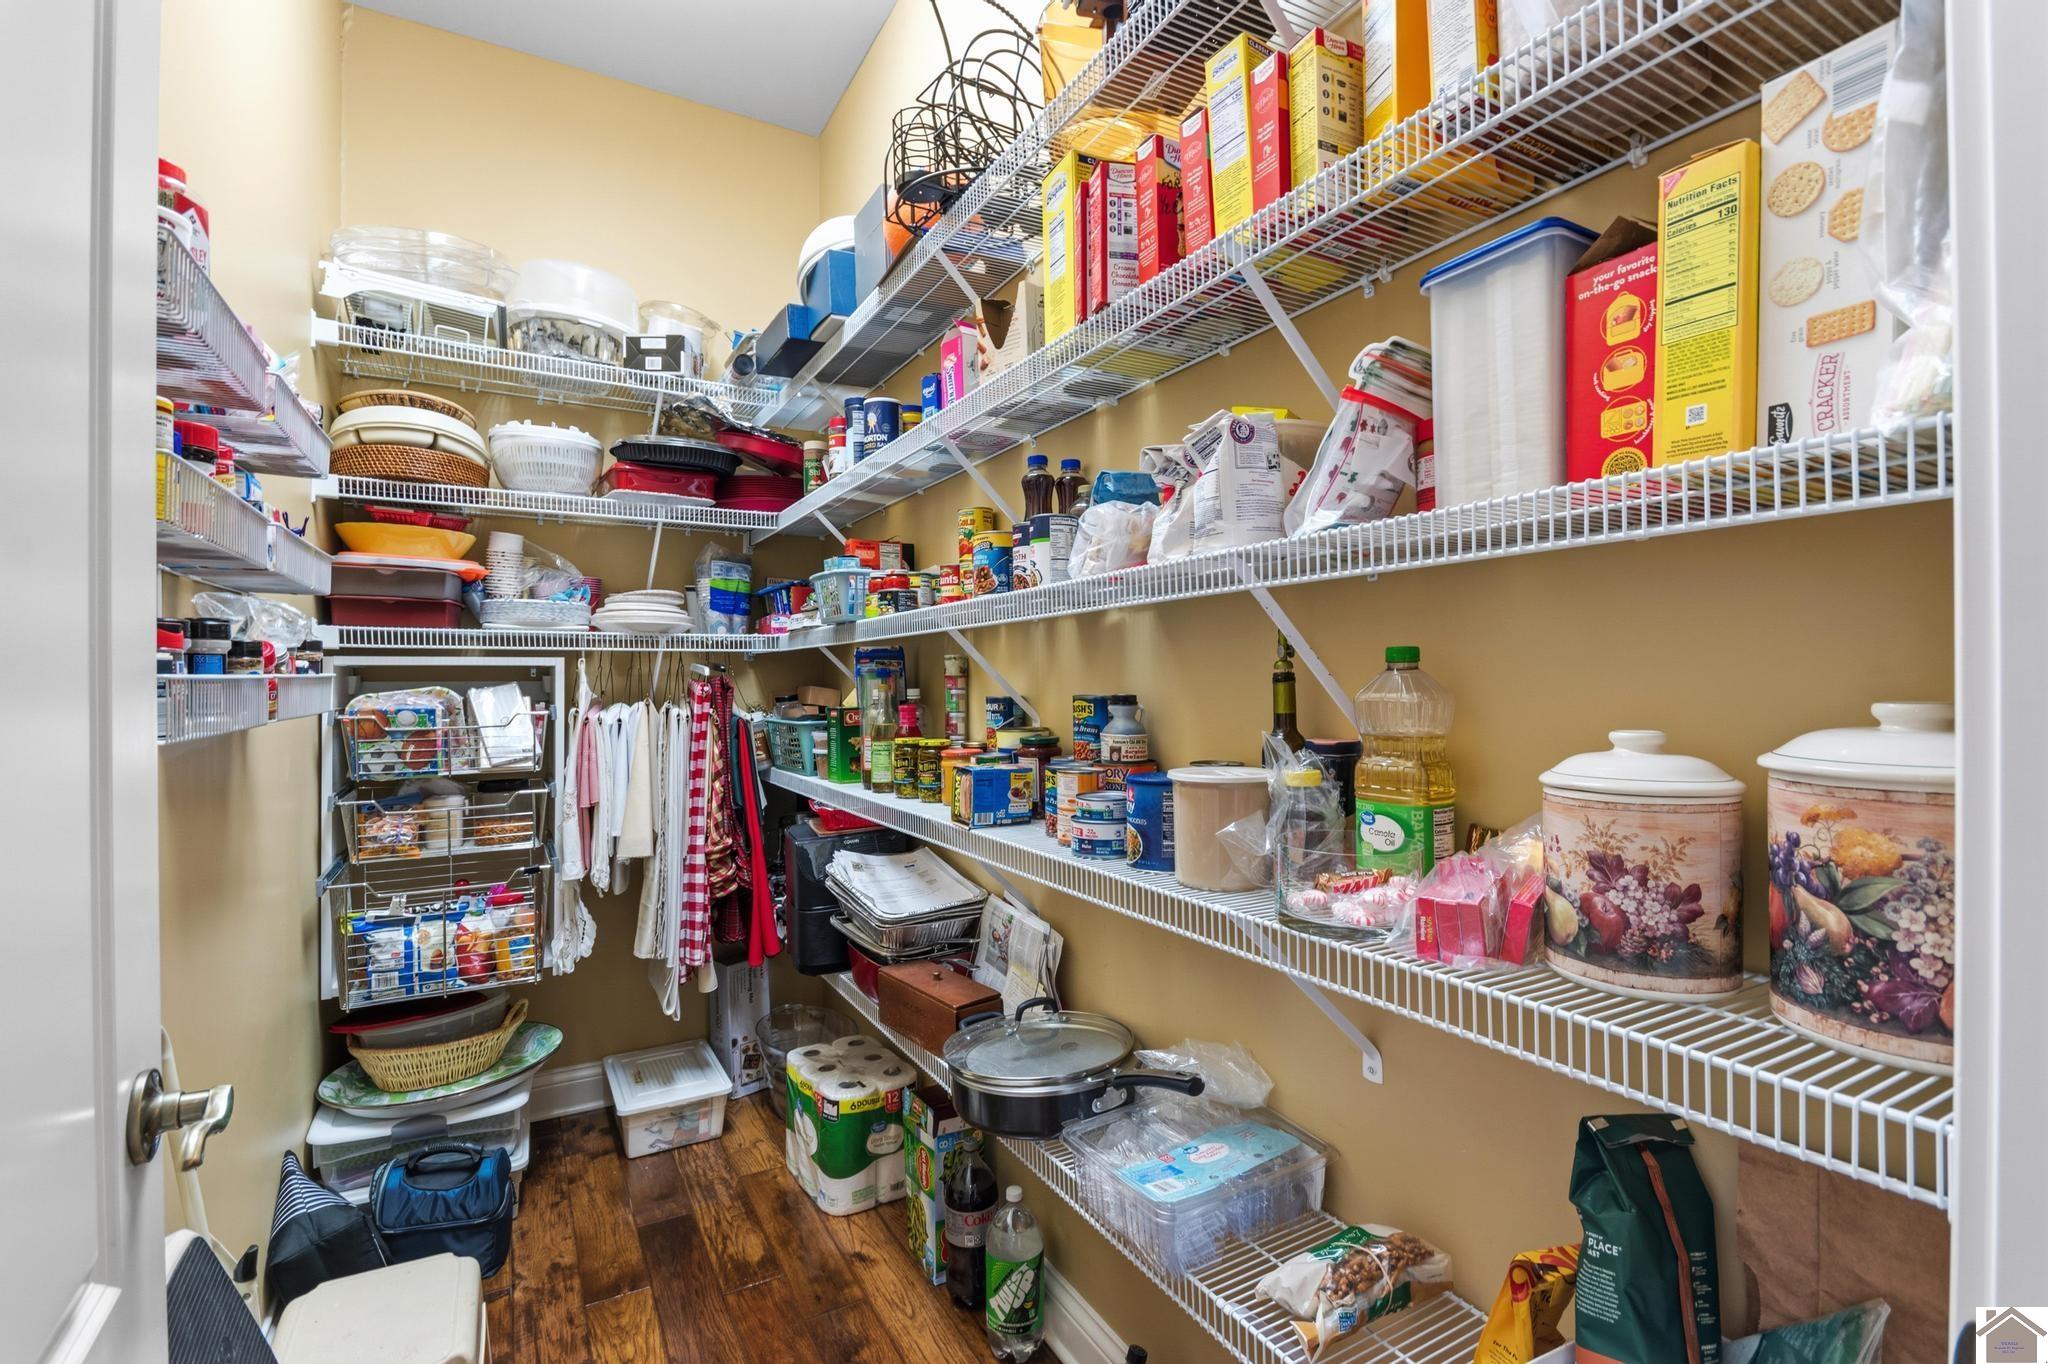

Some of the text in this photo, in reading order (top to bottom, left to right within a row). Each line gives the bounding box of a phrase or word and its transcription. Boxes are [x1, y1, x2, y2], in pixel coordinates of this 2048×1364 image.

[1667, 176, 1738, 209] Nutrition Facts
[1718, 203, 1738, 219] 130
[1666, 222, 1697, 238] Calories
[1592, 254, 1656, 287] your favorite
[1578, 265, 1658, 301] on-the-go snack
[1815, 352, 1840, 432] CRACKER
[1843, 371, 1851, 421] ASSORTMENT
[1368, 827, 1396, 839] Canola
[1384, 838, 1396, 847] Oil
[887, 1090, 899, 1104] 12
